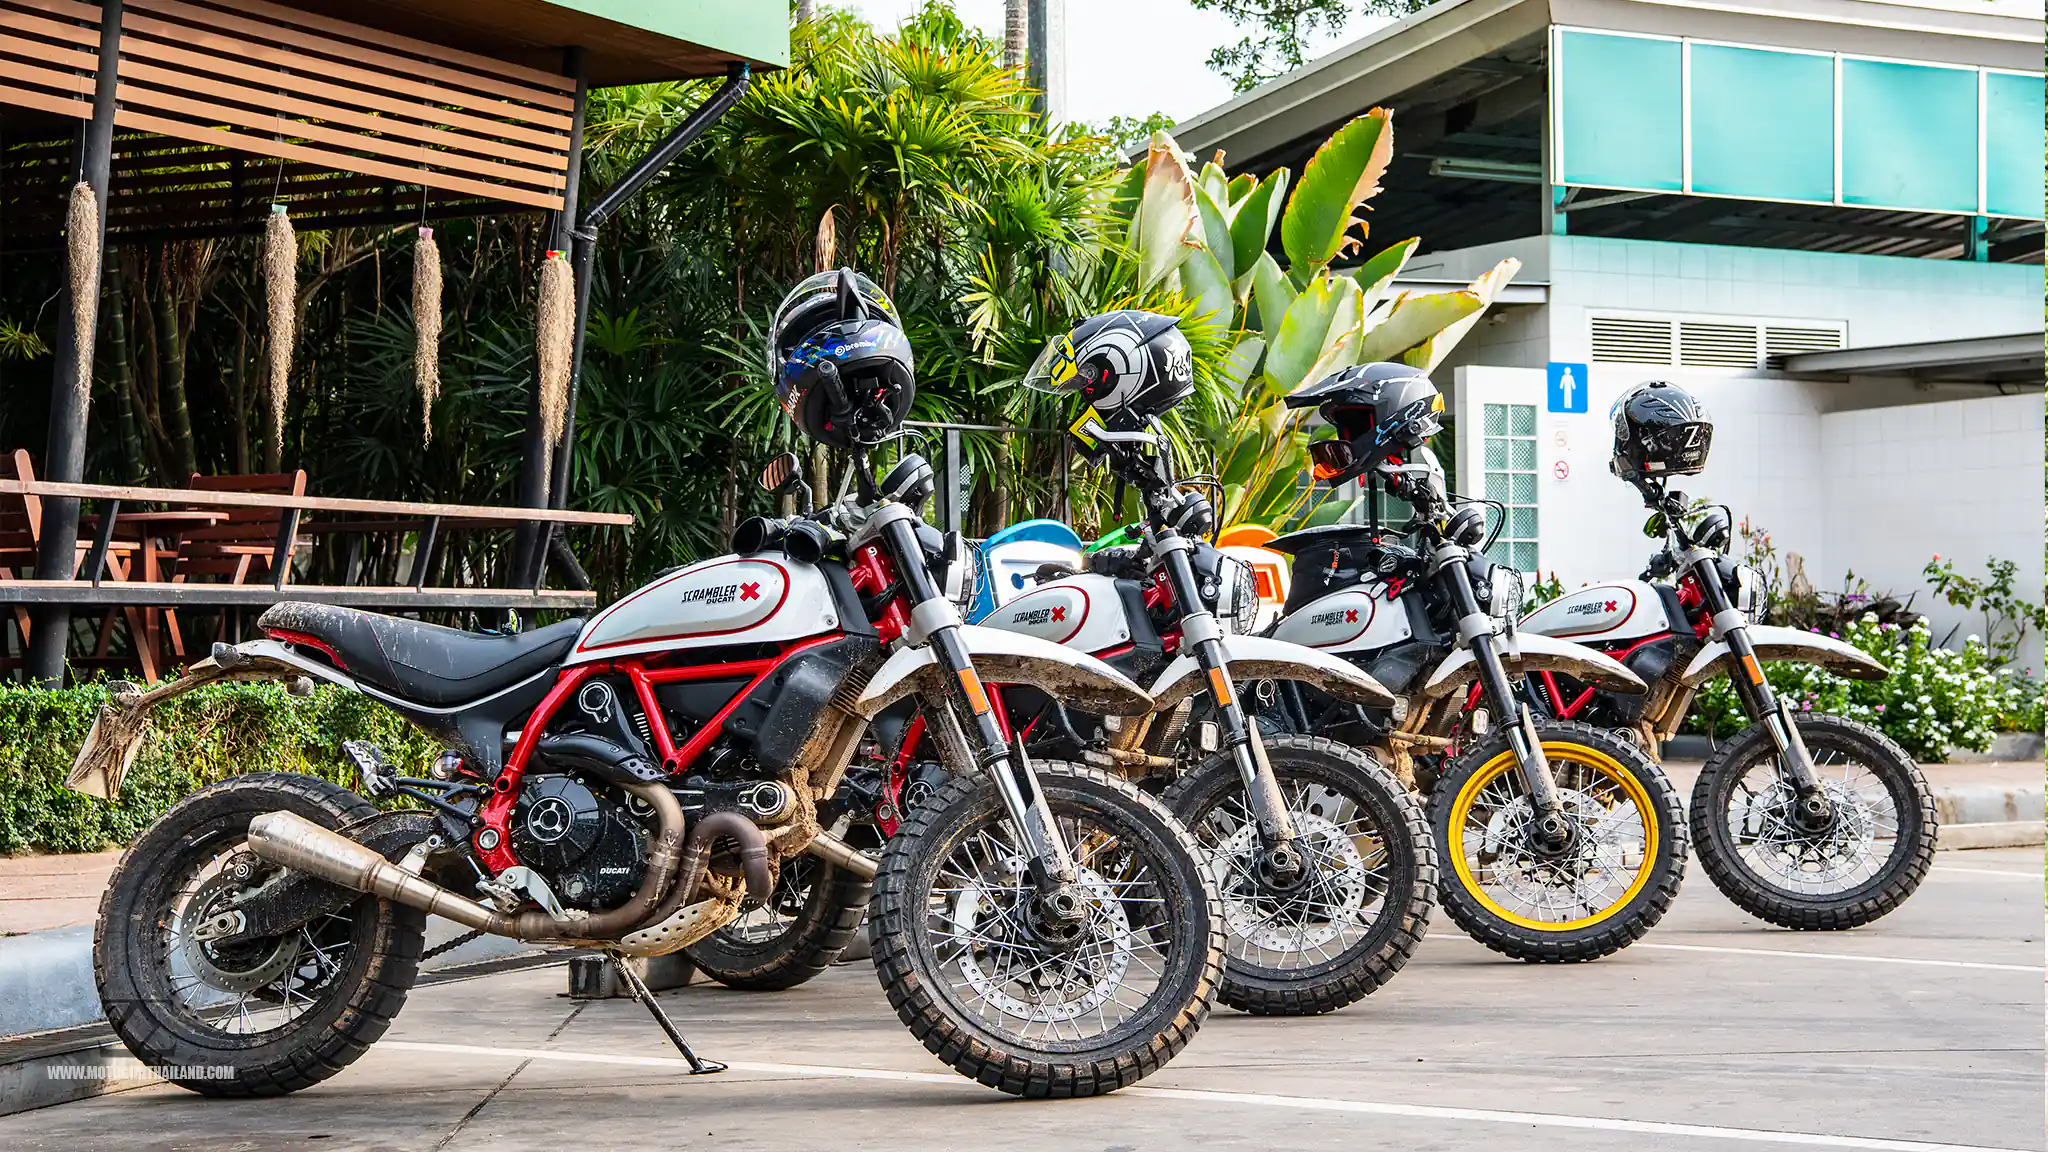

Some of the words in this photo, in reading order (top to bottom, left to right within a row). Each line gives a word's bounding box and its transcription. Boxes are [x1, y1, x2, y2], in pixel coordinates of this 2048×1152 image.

[1684, 425, 1700, 448] Z
[867, 546, 878, 557] 9
[1158, 571, 1167, 582] 8
[1687, 576, 1695, 584] 5
[681, 584, 737, 604] SCRAMBLER
[706, 596, 735, 605] DUCATI
[1567, 601, 1603, 615] SCRAMBLER
[1012, 608, 1050, 624] SCRAMBLER
[1028, 617, 1048, 626] DUCATI
[1310, 610, 1344, 625] SCRAMBLER
[600, 867, 630, 875] DUCATI
